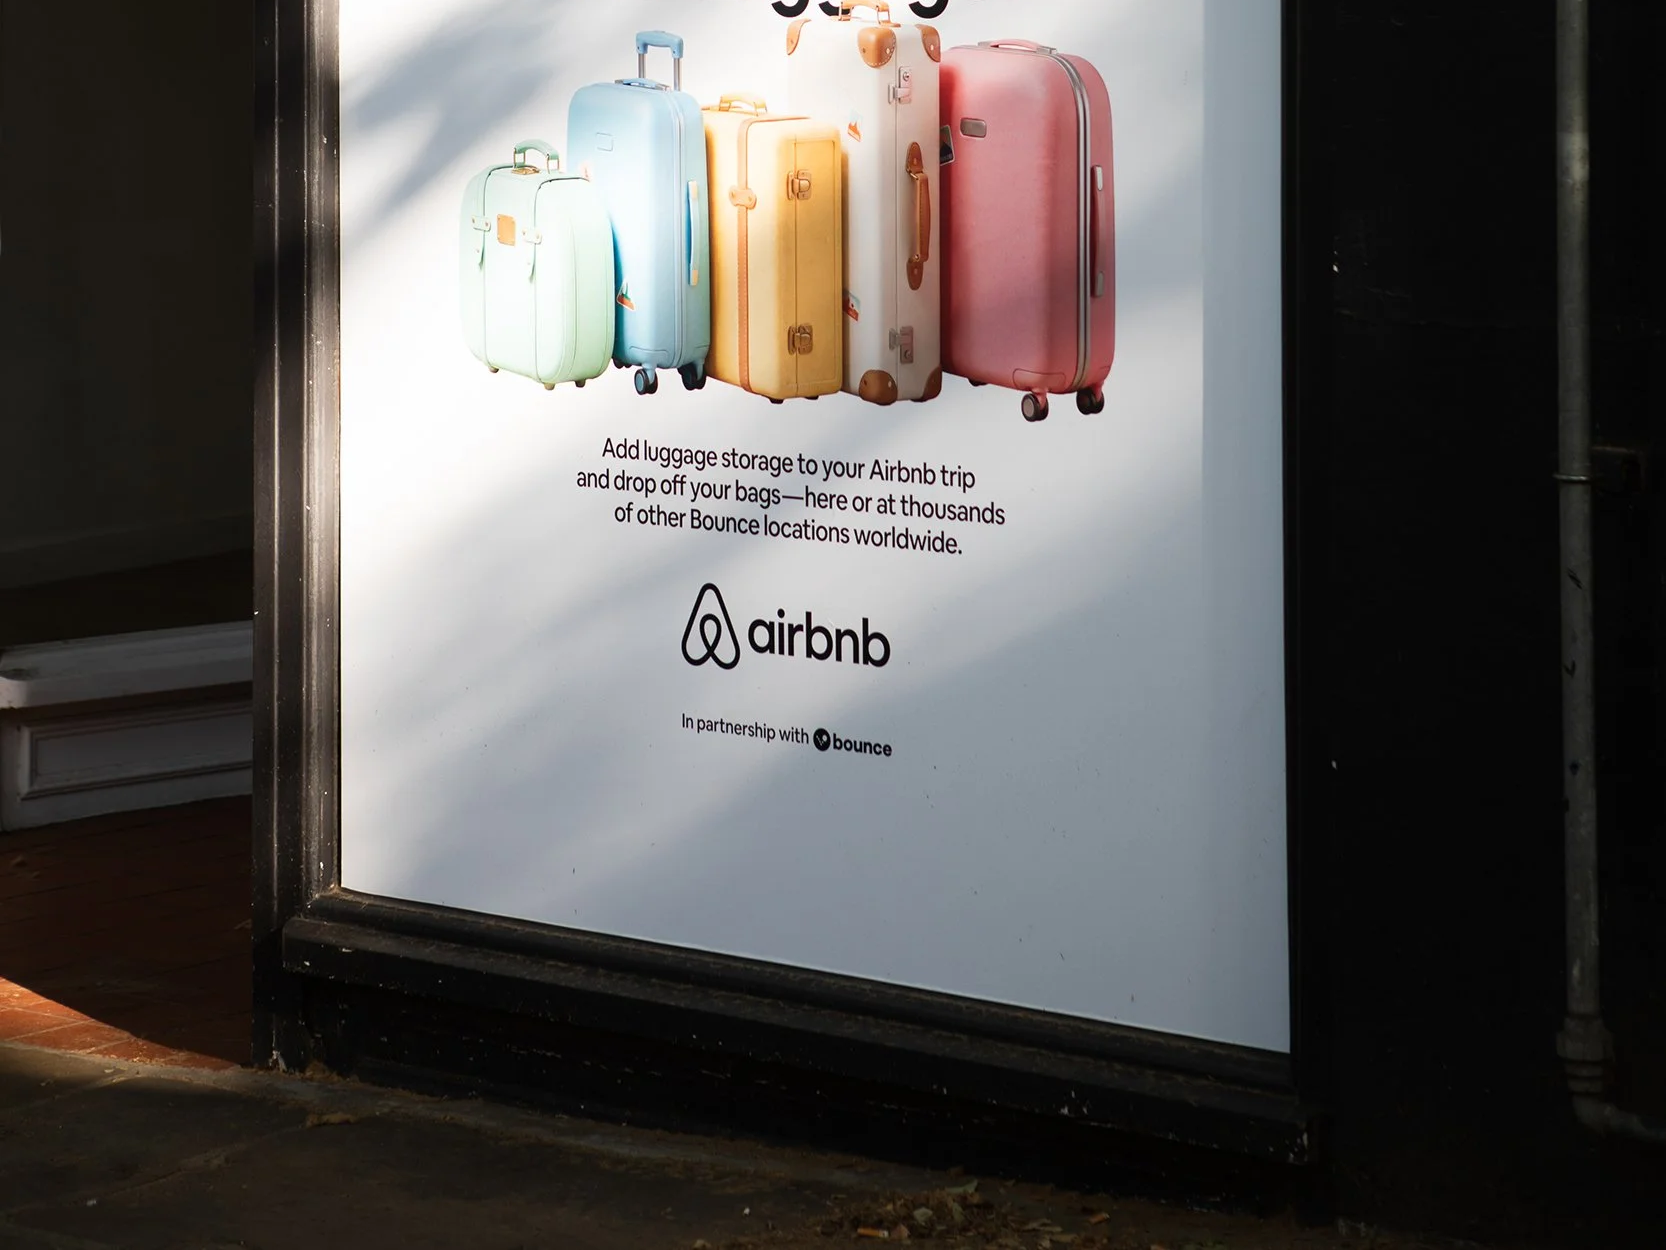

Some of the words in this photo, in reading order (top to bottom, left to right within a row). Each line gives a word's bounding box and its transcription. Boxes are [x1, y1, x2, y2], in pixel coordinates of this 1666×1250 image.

[601, 437, 640, 460] Add
[644, 439, 718, 472] luggage
[721, 447, 794, 478] storage
[796, 452, 819, 476] to
[821, 459, 866, 482] your
[869, 458, 937, 486] Airbnb
[939, 464, 976, 494] trip
[576, 468, 610, 490] and
[613, 469, 657, 499] drop
[660, 473, 687, 496] off
[689, 481, 732, 503] your
[851, 495, 873, 513] or
[876, 493, 897, 516] at
[899, 494, 1006, 526] thousands
[614, 501, 634, 523] of
[636, 504, 687, 528] other
[690, 508, 761, 536] Bounce
[763, 513, 850, 544] locations
[853, 525, 963, 555] worldwide.
[747, 608, 891, 668] airbnb
[681, 712, 694, 730] In
[696, 717, 776, 744] partnership
[778, 727, 810, 745] with
[832, 732, 893, 758] bounce
